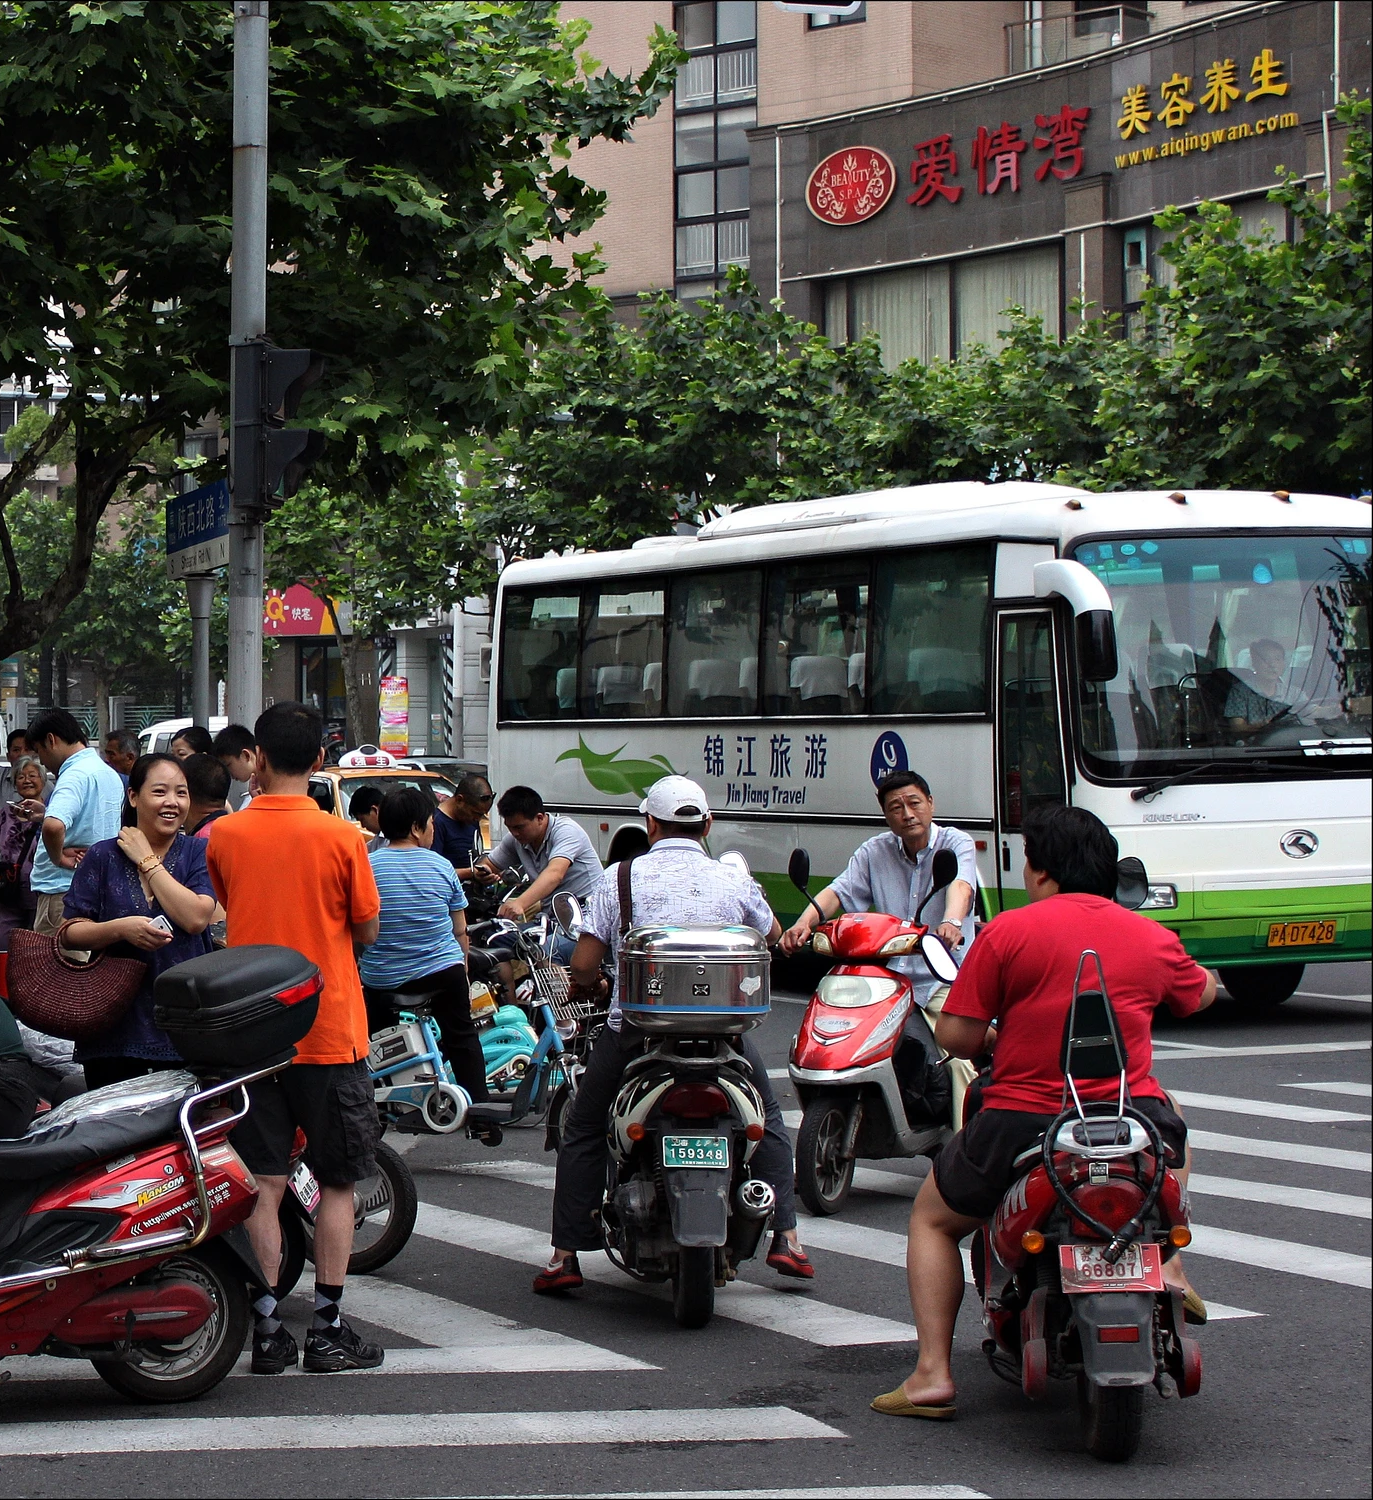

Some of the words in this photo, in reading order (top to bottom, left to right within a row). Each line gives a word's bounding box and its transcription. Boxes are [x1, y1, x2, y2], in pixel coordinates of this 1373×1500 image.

[1116, 48, 1290, 141] 美容养生
[906, 104, 1091, 207] 爱情湾
[1115, 111, 1299, 169] www.aiqingwan.com
[831, 168, 871, 187] BEAUTY
[177, 494, 215, 539] 陕西北路
[703, 733, 828, 779] 锦江旅游
[772, 786, 806, 806] Travel
[1143, 813, 1206, 823] KING-LON
[670, 1148, 723, 1160] 159348
[136, 1174, 185, 1208] HANSOM
[1081, 1263, 1136, 1277] 66807
